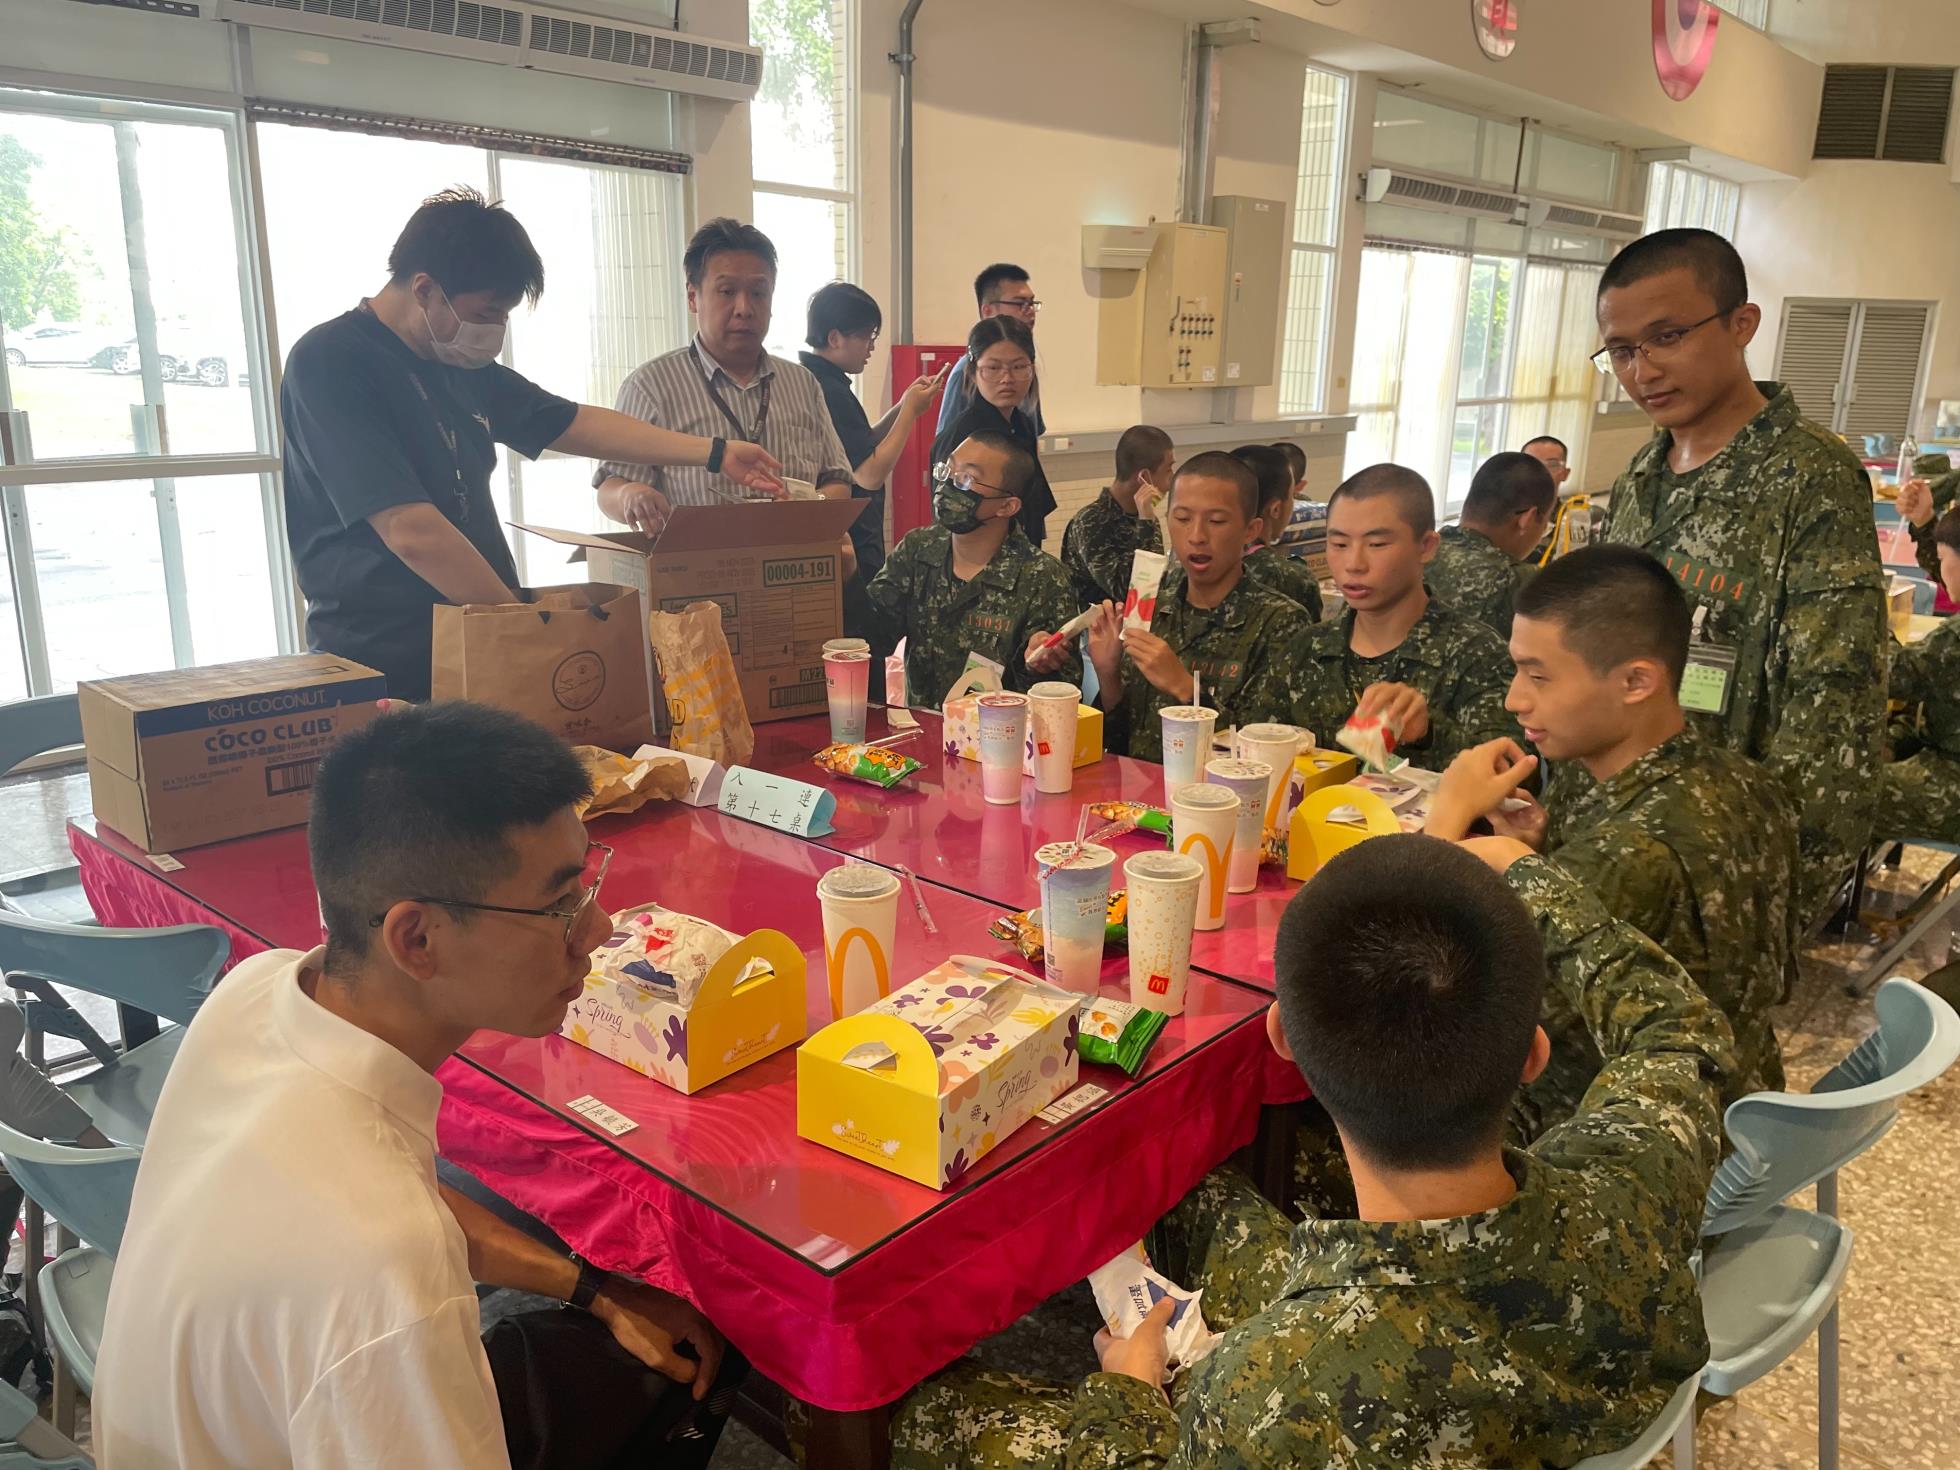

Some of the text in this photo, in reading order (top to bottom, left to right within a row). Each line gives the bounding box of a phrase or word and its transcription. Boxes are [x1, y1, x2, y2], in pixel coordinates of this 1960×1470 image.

[766, 561, 832, 583] 00004-191
[1664, 556, 1744, 601] 14104
[207, 689, 326, 721] KOH COCONUT
[272, 717, 333, 740] CLUB
[725, 792, 802, 833] 第十七桌
[587, 998, 625, 1034] Spring
[996, 1070, 1034, 1113] Spring
